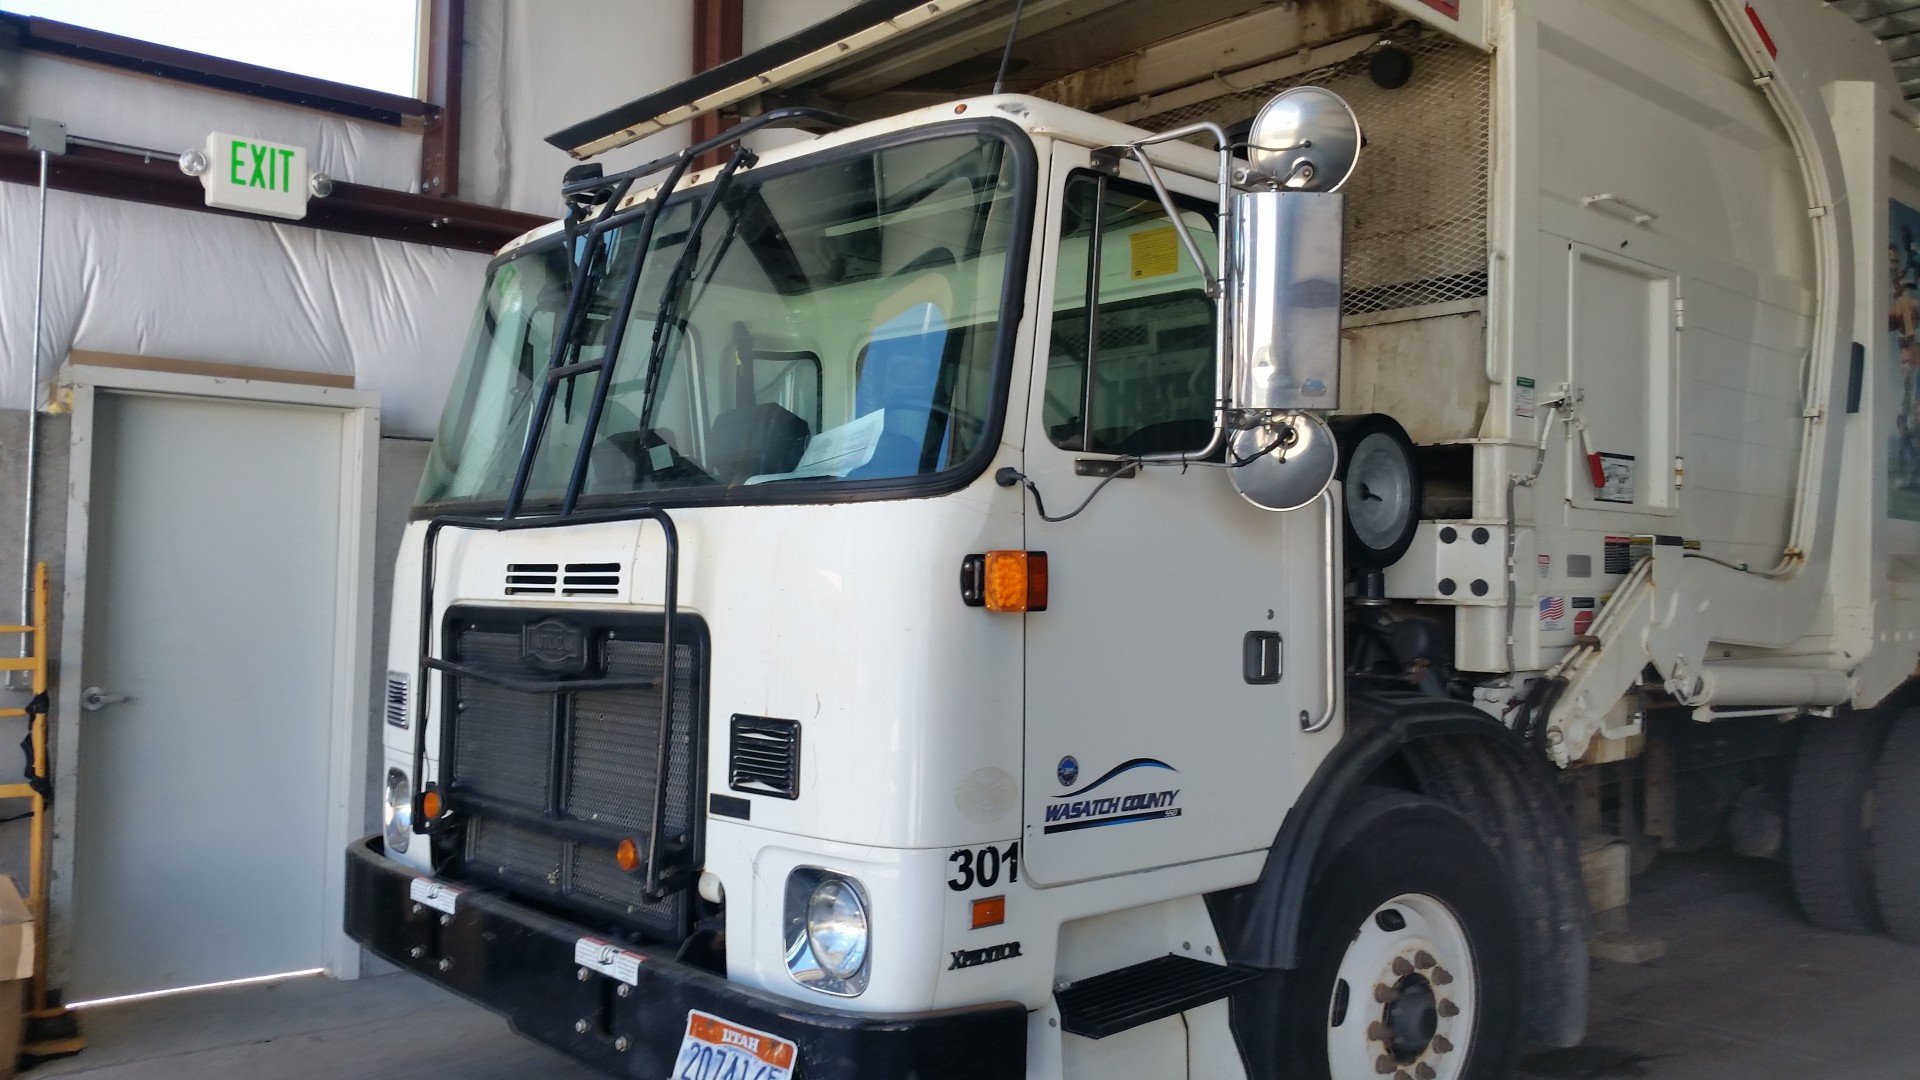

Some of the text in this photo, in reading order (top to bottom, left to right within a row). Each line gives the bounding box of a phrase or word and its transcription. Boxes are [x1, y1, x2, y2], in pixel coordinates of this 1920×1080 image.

[231, 140, 295, 193] EXIT
[1045, 789, 1181, 823] WASATCH COUNTY
[947, 841, 1019, 892] 301
[720, 1027, 760, 1053] UTAH
